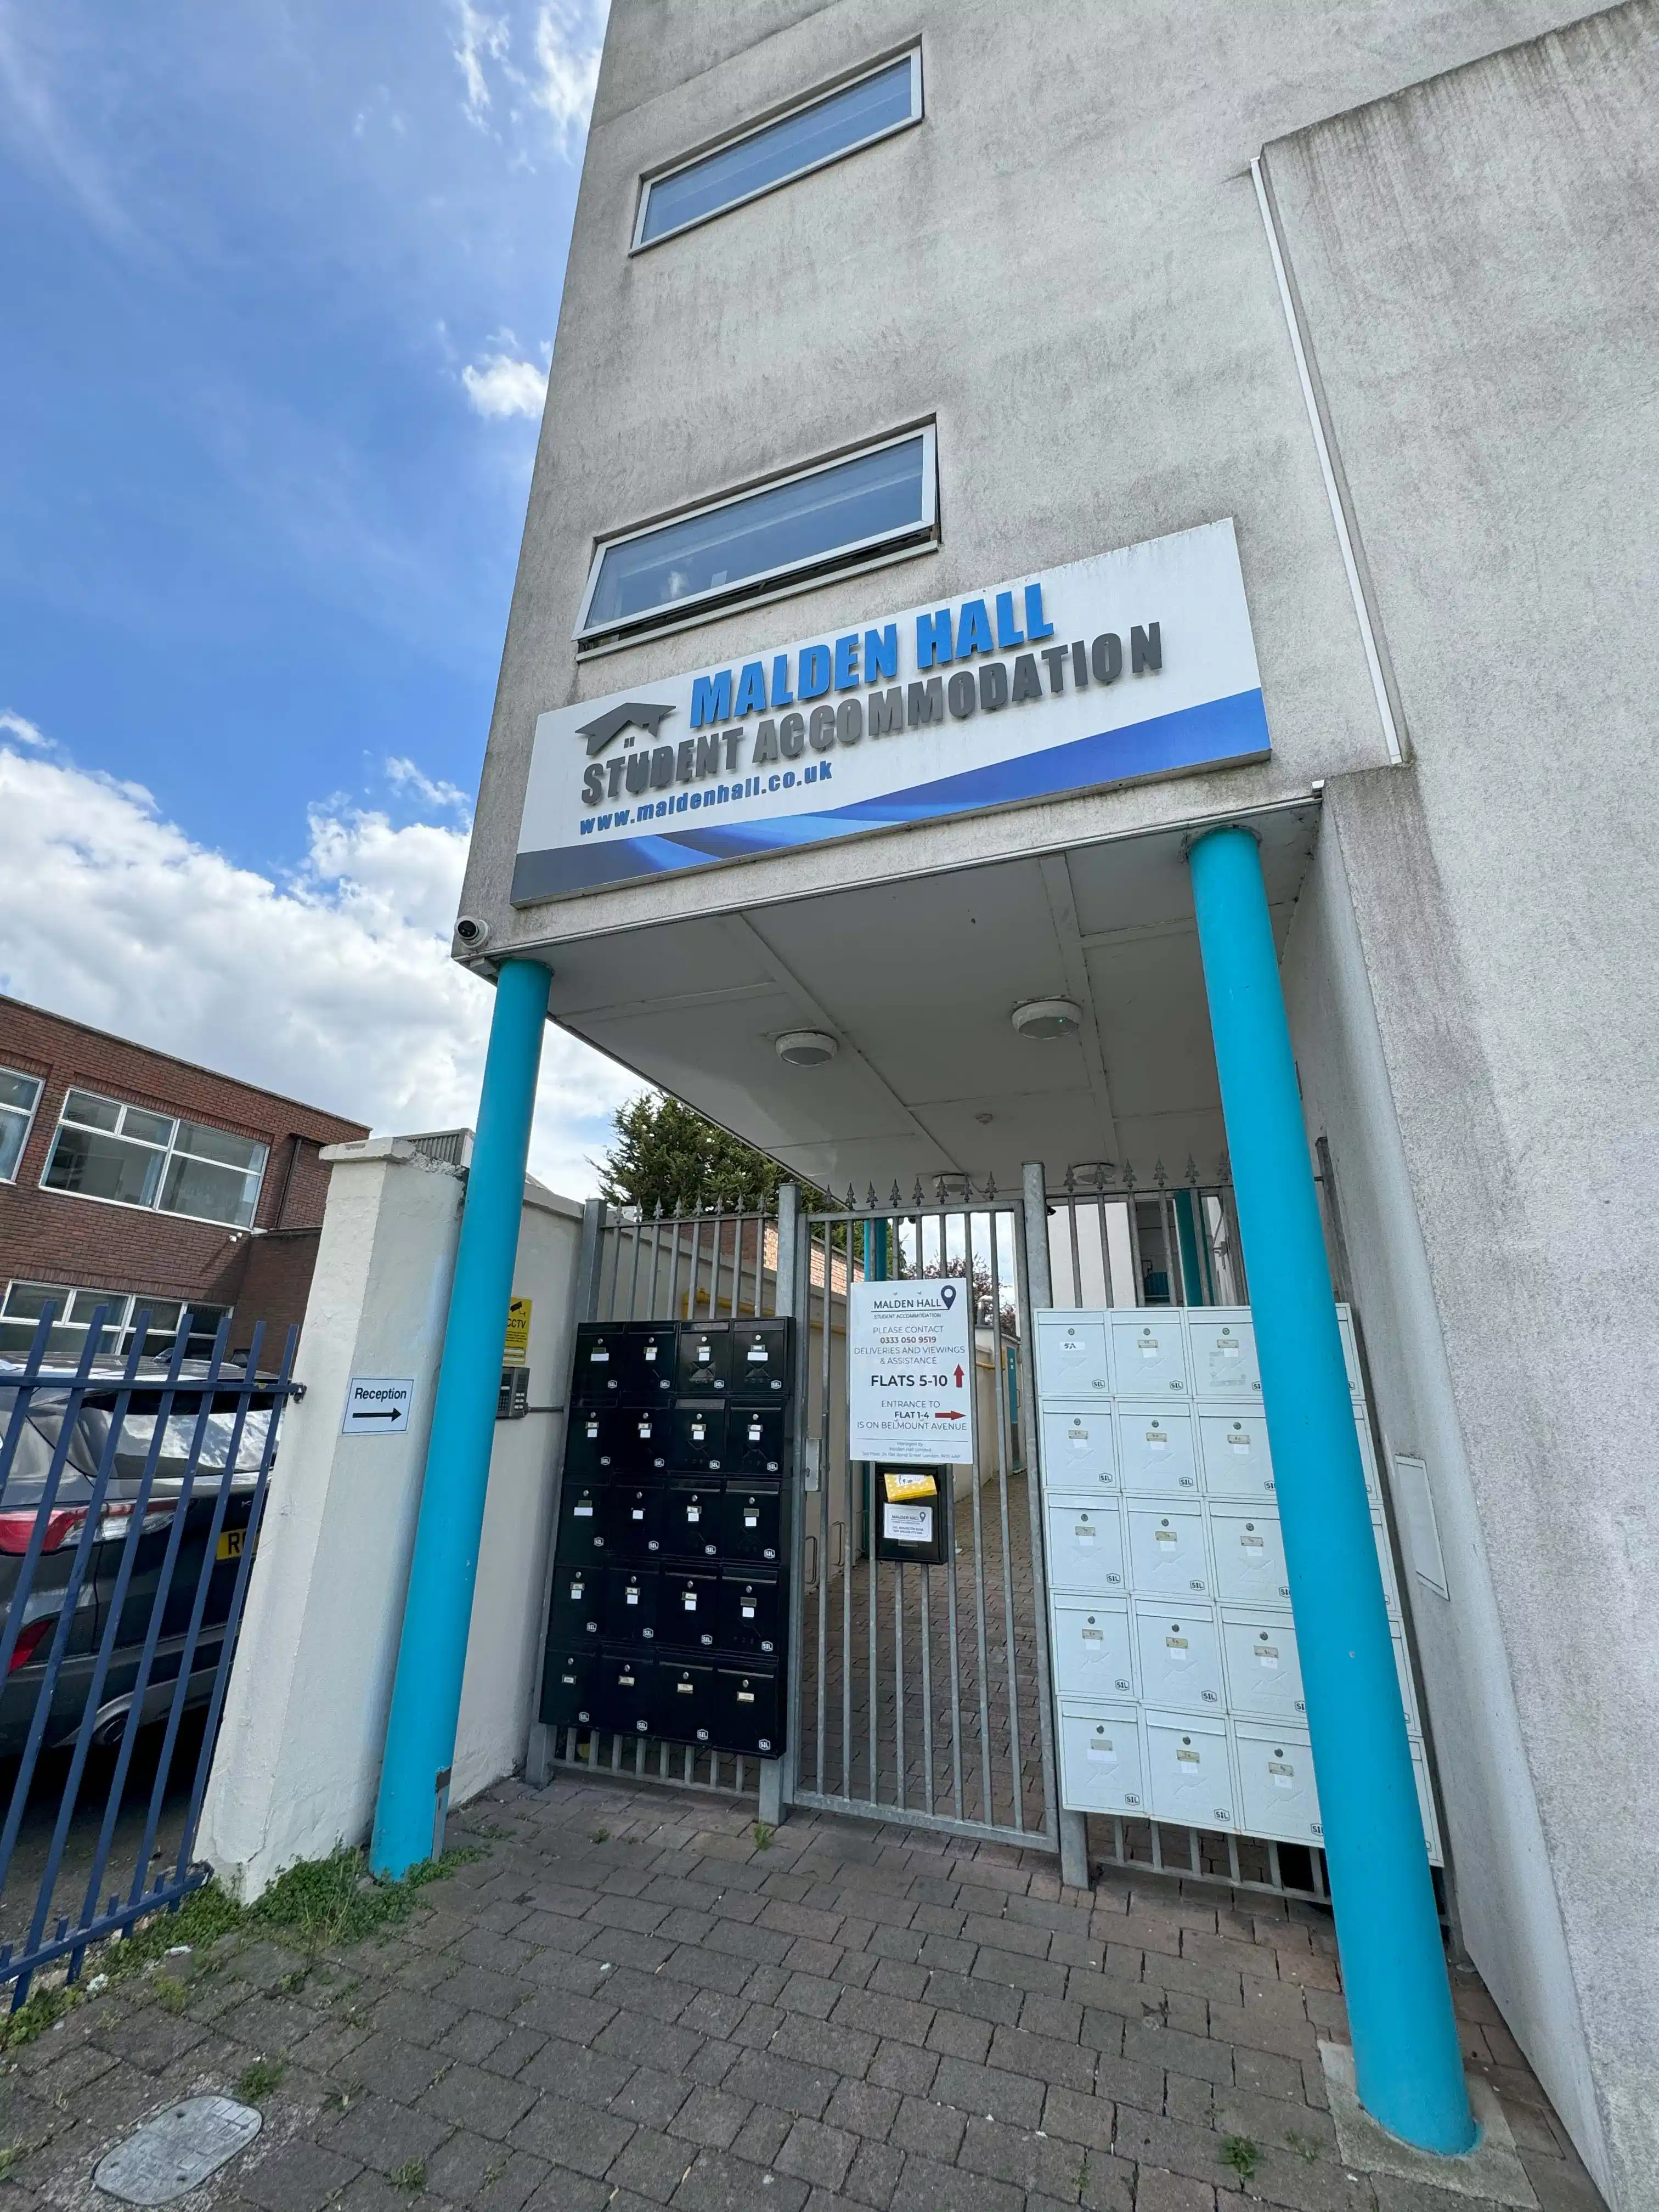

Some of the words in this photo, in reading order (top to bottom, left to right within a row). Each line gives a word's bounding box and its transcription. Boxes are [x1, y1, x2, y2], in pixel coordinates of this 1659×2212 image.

[690, 623, 897, 729] MALDEN
[916, 583, 1054, 669] HALL
[581, 727, 743, 804] STUDENT
[752, 622, 1162, 763] ACCOMMODATION
[580, 761, 832, 835] www.maldenhall.co.uk
[873, 1300, 914, 1309] MALDEN
[917, 1299, 941, 1307] HALL
[873, 1326, 905, 1334] PLEASE
[871, 1375, 915, 1387] FLATS
[919, 1375, 948, 1387] 5-10
[354, 1387, 407, 1402] Reception
[928, 1400, 940, 1408] TO
[881, 1421, 928, 1430] BELMOUNT
[931, 1423, 967, 1431] AVENUE
[1215, 1811, 1228, 1819] SIL
